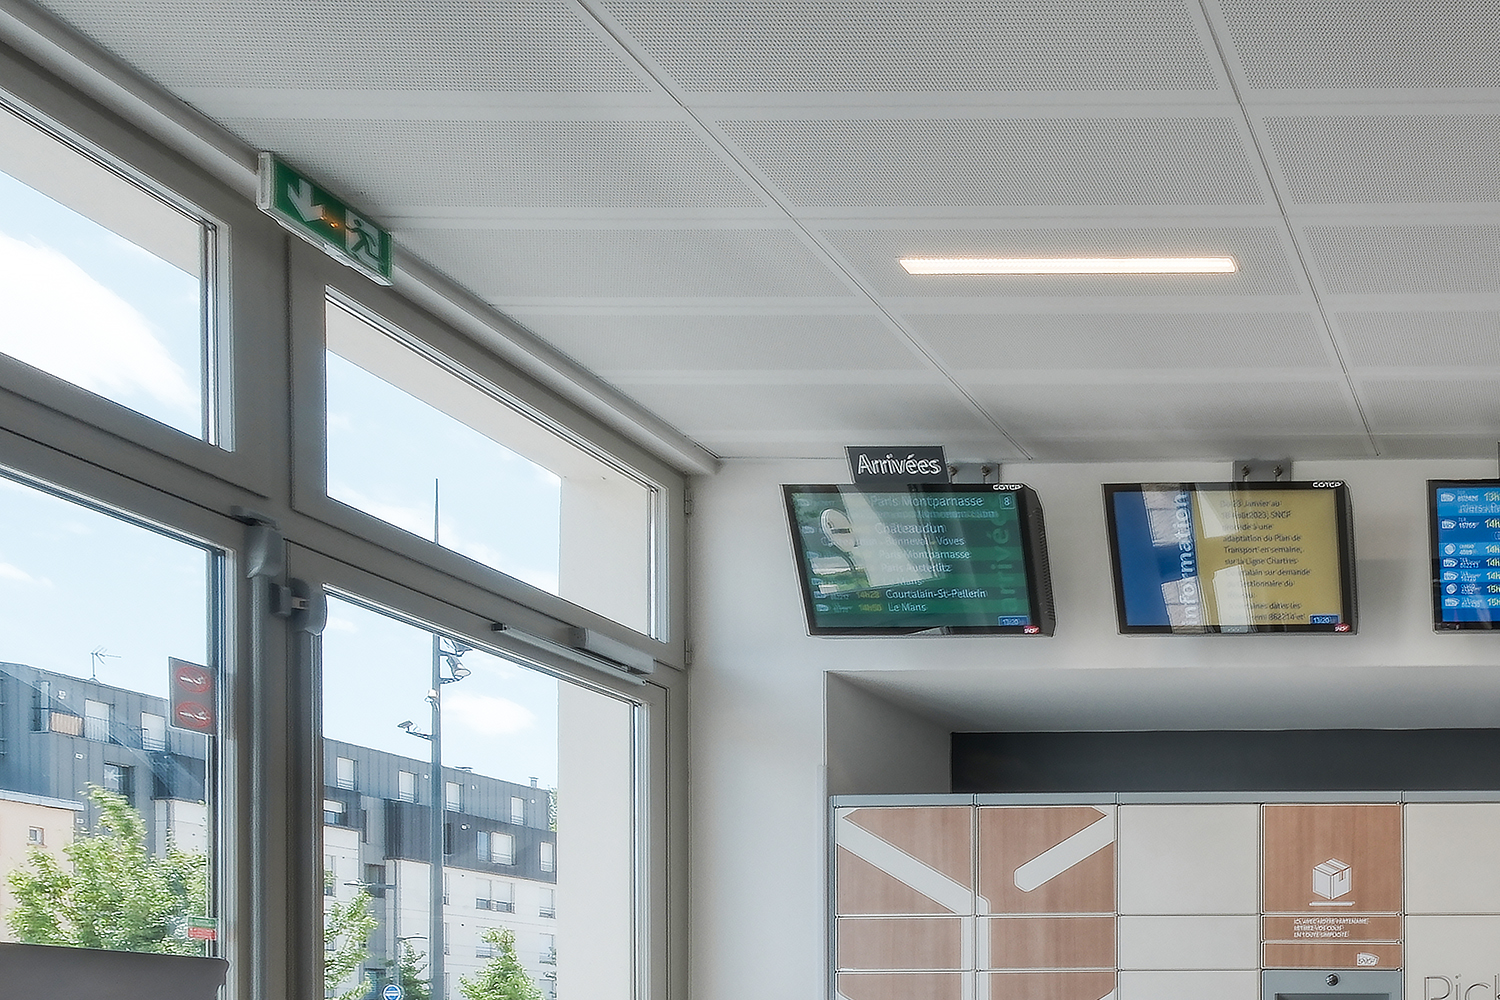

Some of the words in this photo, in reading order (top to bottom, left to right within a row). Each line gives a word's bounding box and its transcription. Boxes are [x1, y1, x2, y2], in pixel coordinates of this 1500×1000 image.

[857, 453, 943, 475] Arrivées
[903, 495, 985, 509] Montparnasse
[936, 537, 966, 546] Voves
[1274, 534, 1290, 542] Plan
[1291, 534, 1302, 542] de
[1223, 545, 1258, 555] Transport
[1277, 568, 1311, 577] demande
[885, 588, 988, 600] Courtalain-St-Pellerin
[888, 602, 900, 612] Le
[901, 602, 927, 612] Mans
